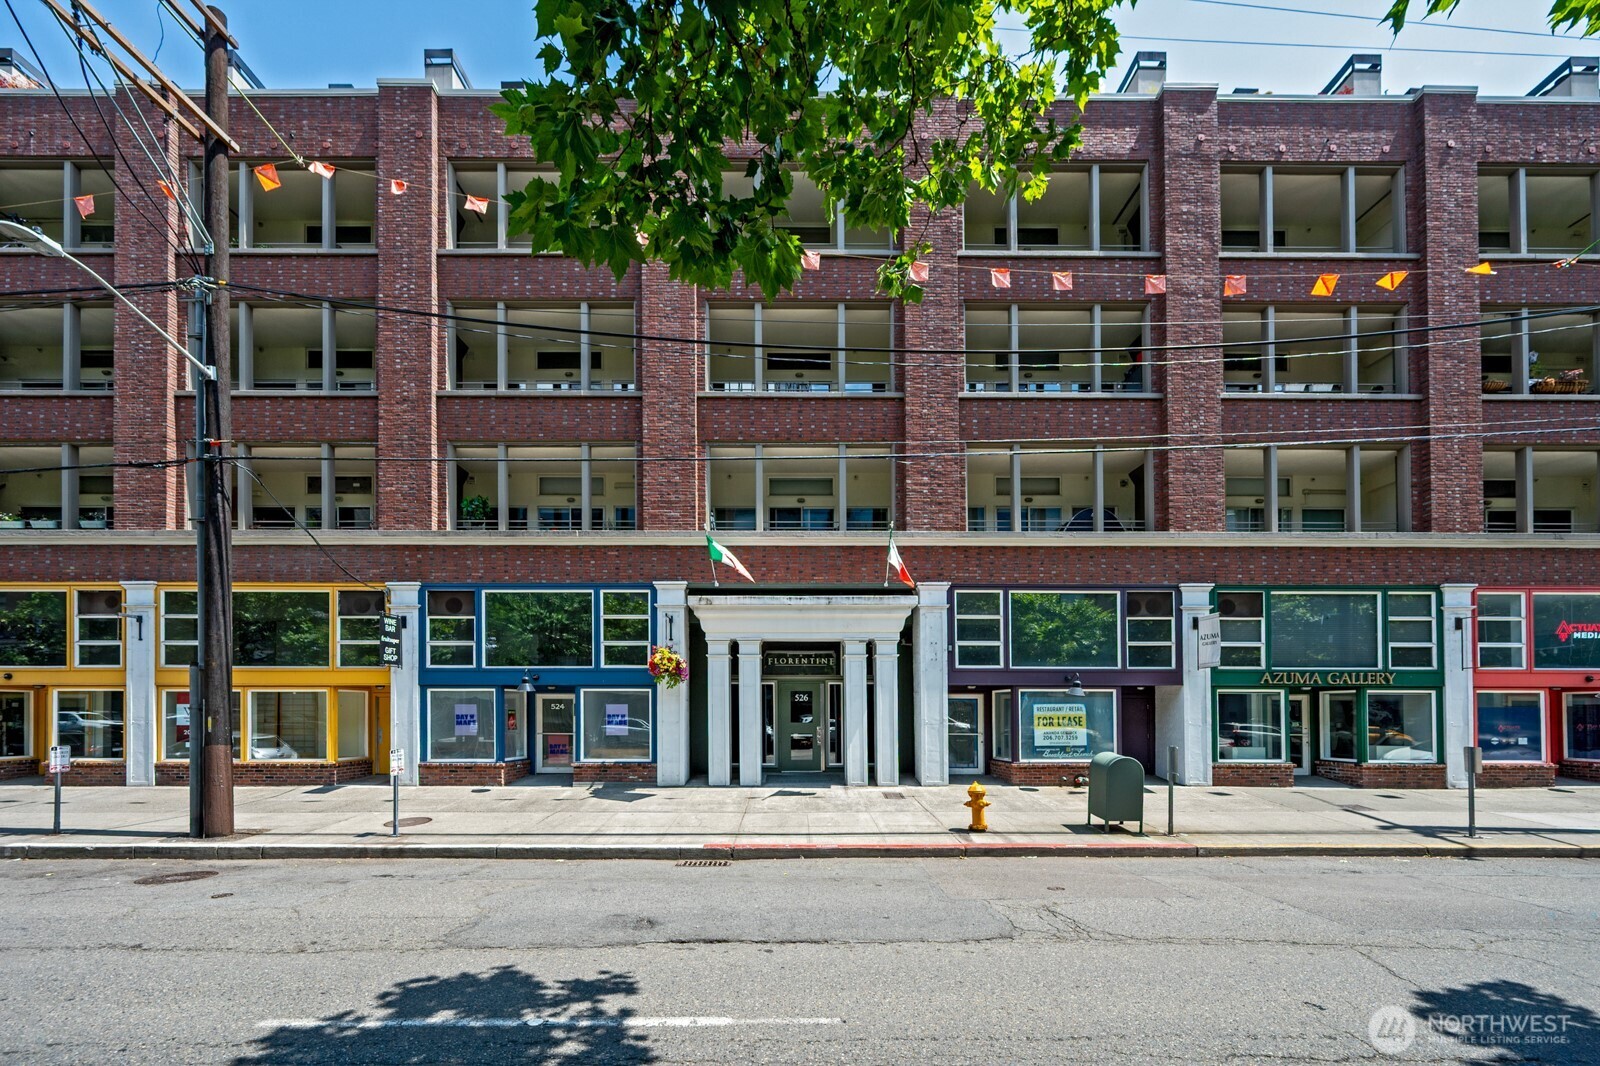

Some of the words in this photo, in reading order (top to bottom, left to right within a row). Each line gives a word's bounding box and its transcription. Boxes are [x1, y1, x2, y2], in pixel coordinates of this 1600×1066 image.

[384, 617, 397, 626] WINE
[385, 625, 396, 633] BAR
[1200, 632, 1220, 641] AZUMA
[385, 646, 396, 654] GIFT
[383, 654, 398, 662] SHOP
[768, 657, 836, 665] FLORENTINE
[1260, 672, 1322, 685] AZUMA
[1327, 672, 1396, 685] GALLERY
[794, 694, 809, 702] 526
[1037, 716, 1055, 727] FOR
[1057, 716, 1083, 727] LEASE
